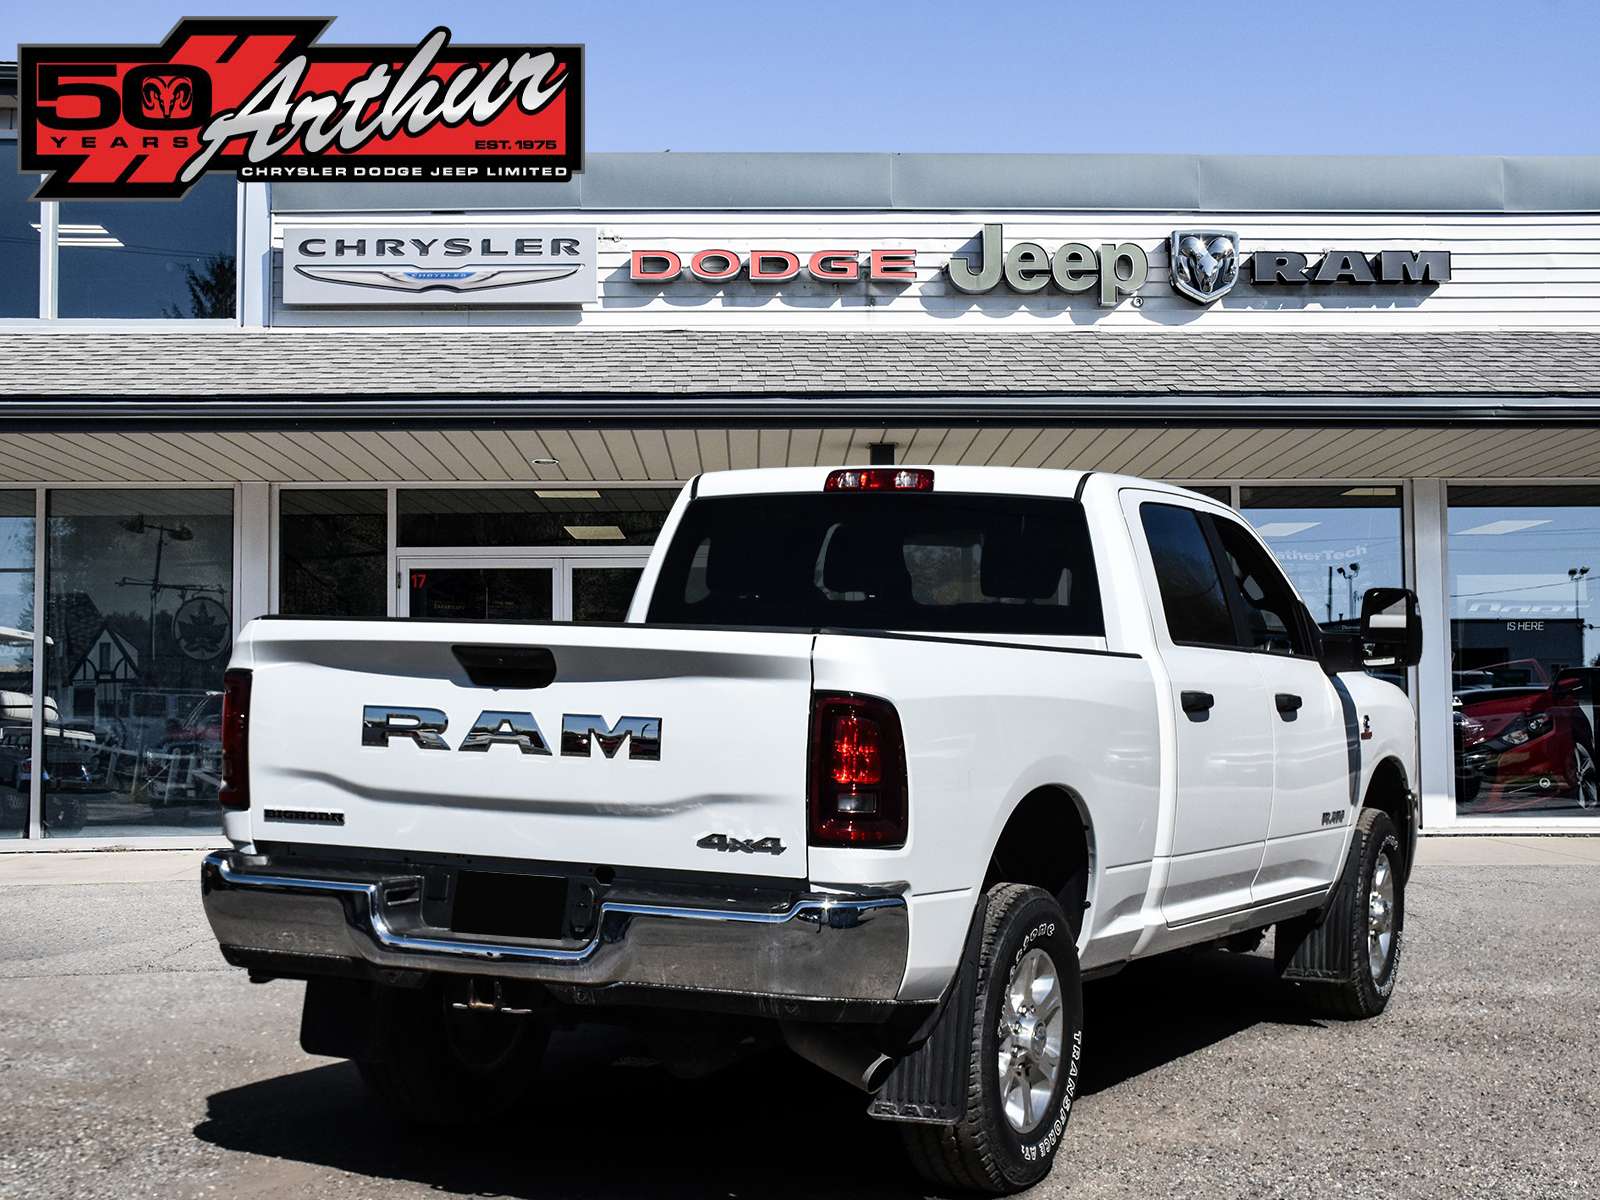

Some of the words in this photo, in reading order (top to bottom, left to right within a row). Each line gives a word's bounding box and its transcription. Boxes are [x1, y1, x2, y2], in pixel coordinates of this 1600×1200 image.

[298, 238, 581, 257] CHRYSLER
[629, 249, 918, 283] DODGE
[949, 223, 1149, 307] Jeep
[1250, 250, 1452, 285] RAM
[411, 574, 427, 589] 17
[1506, 621, 1517, 631] IS
[1518, 621, 1545, 631] HERE
[362, 705, 663, 761] RAM
